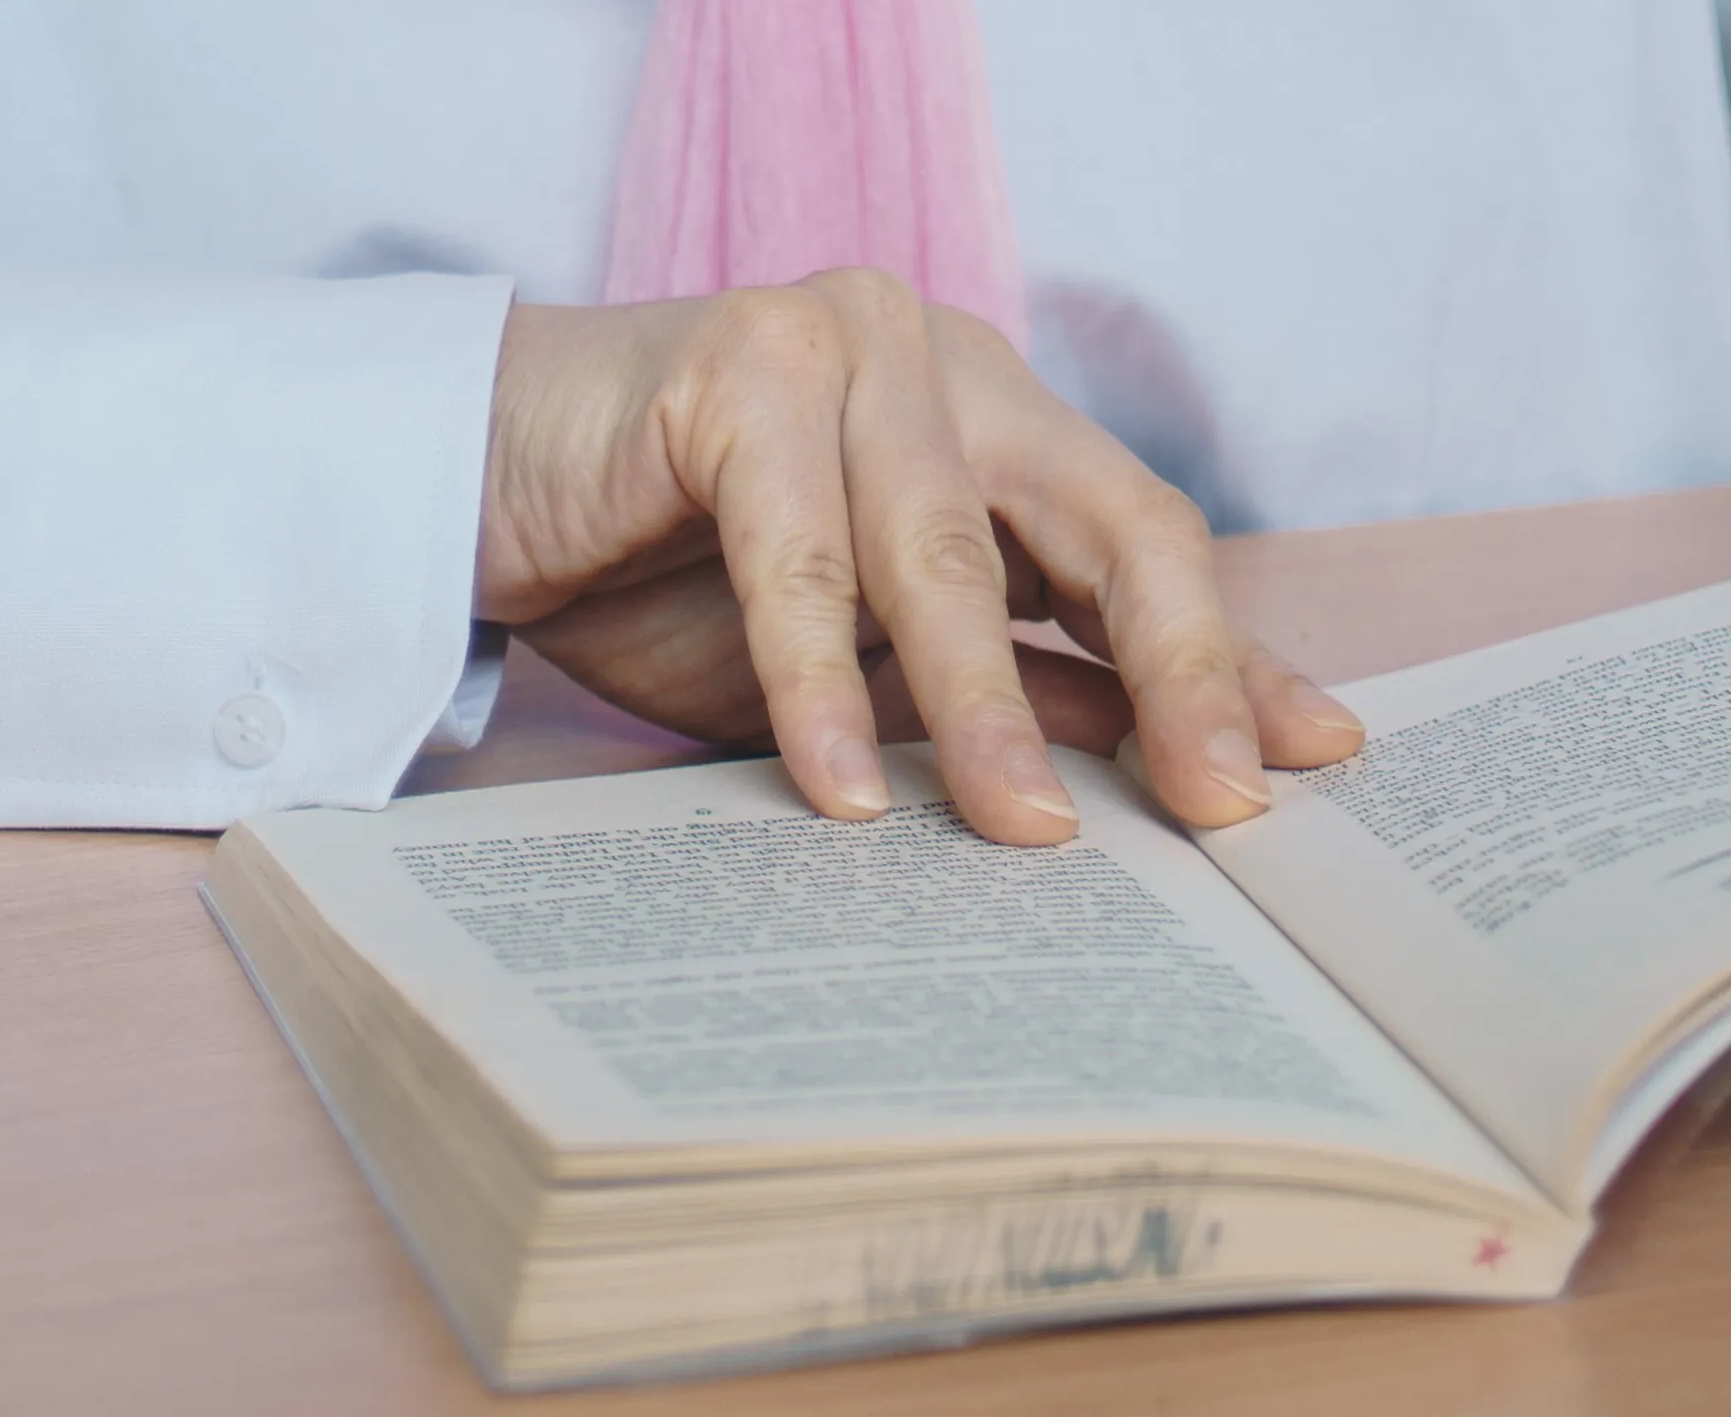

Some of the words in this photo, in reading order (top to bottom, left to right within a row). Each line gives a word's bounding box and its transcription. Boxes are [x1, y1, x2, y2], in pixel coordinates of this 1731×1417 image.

[684, 821, 756, 829] living
[550, 831, 611, 840] most
[681, 827, 772, 838] English
[727, 830, 851, 842] mentioned
[526, 838, 634, 850] stupidest
[707, 840, 803, 850] because
[804, 836, 874, 844] laugh
[845, 837, 966, 848] intelligent
[387, 843, 470, 852] money
[748, 845, 839, 856] enough
[499, 848, 611, 860] Irishman
[600, 852, 659, 861] Irish
[440, 861, 554, 874] supposed
